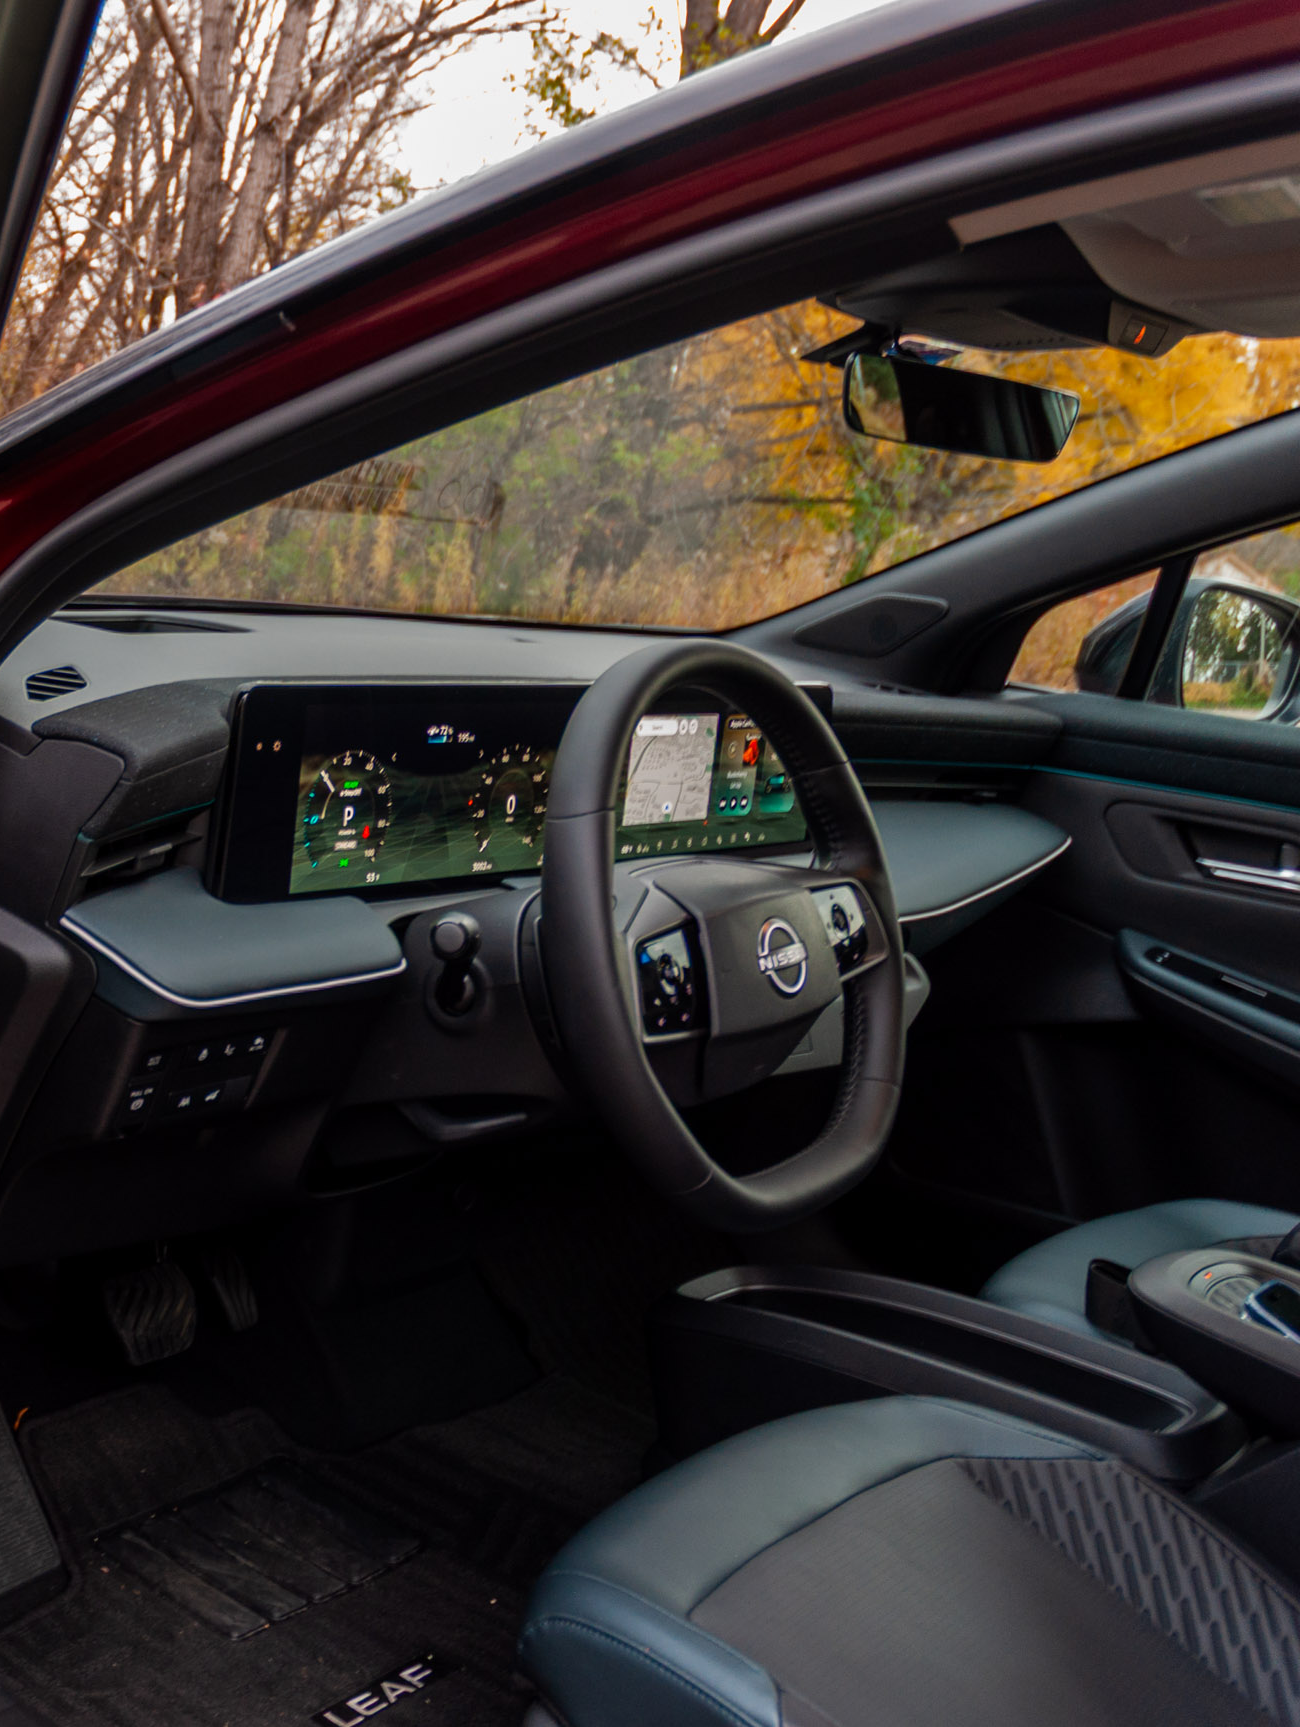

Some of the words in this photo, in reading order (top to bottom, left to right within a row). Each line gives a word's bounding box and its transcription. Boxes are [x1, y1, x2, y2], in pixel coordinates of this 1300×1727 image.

[506, 794, 516, 815] 0
[343, 806, 355, 827] P
[758, 945, 806, 971] NISS
[323, 1663, 433, 1727] LEAF
